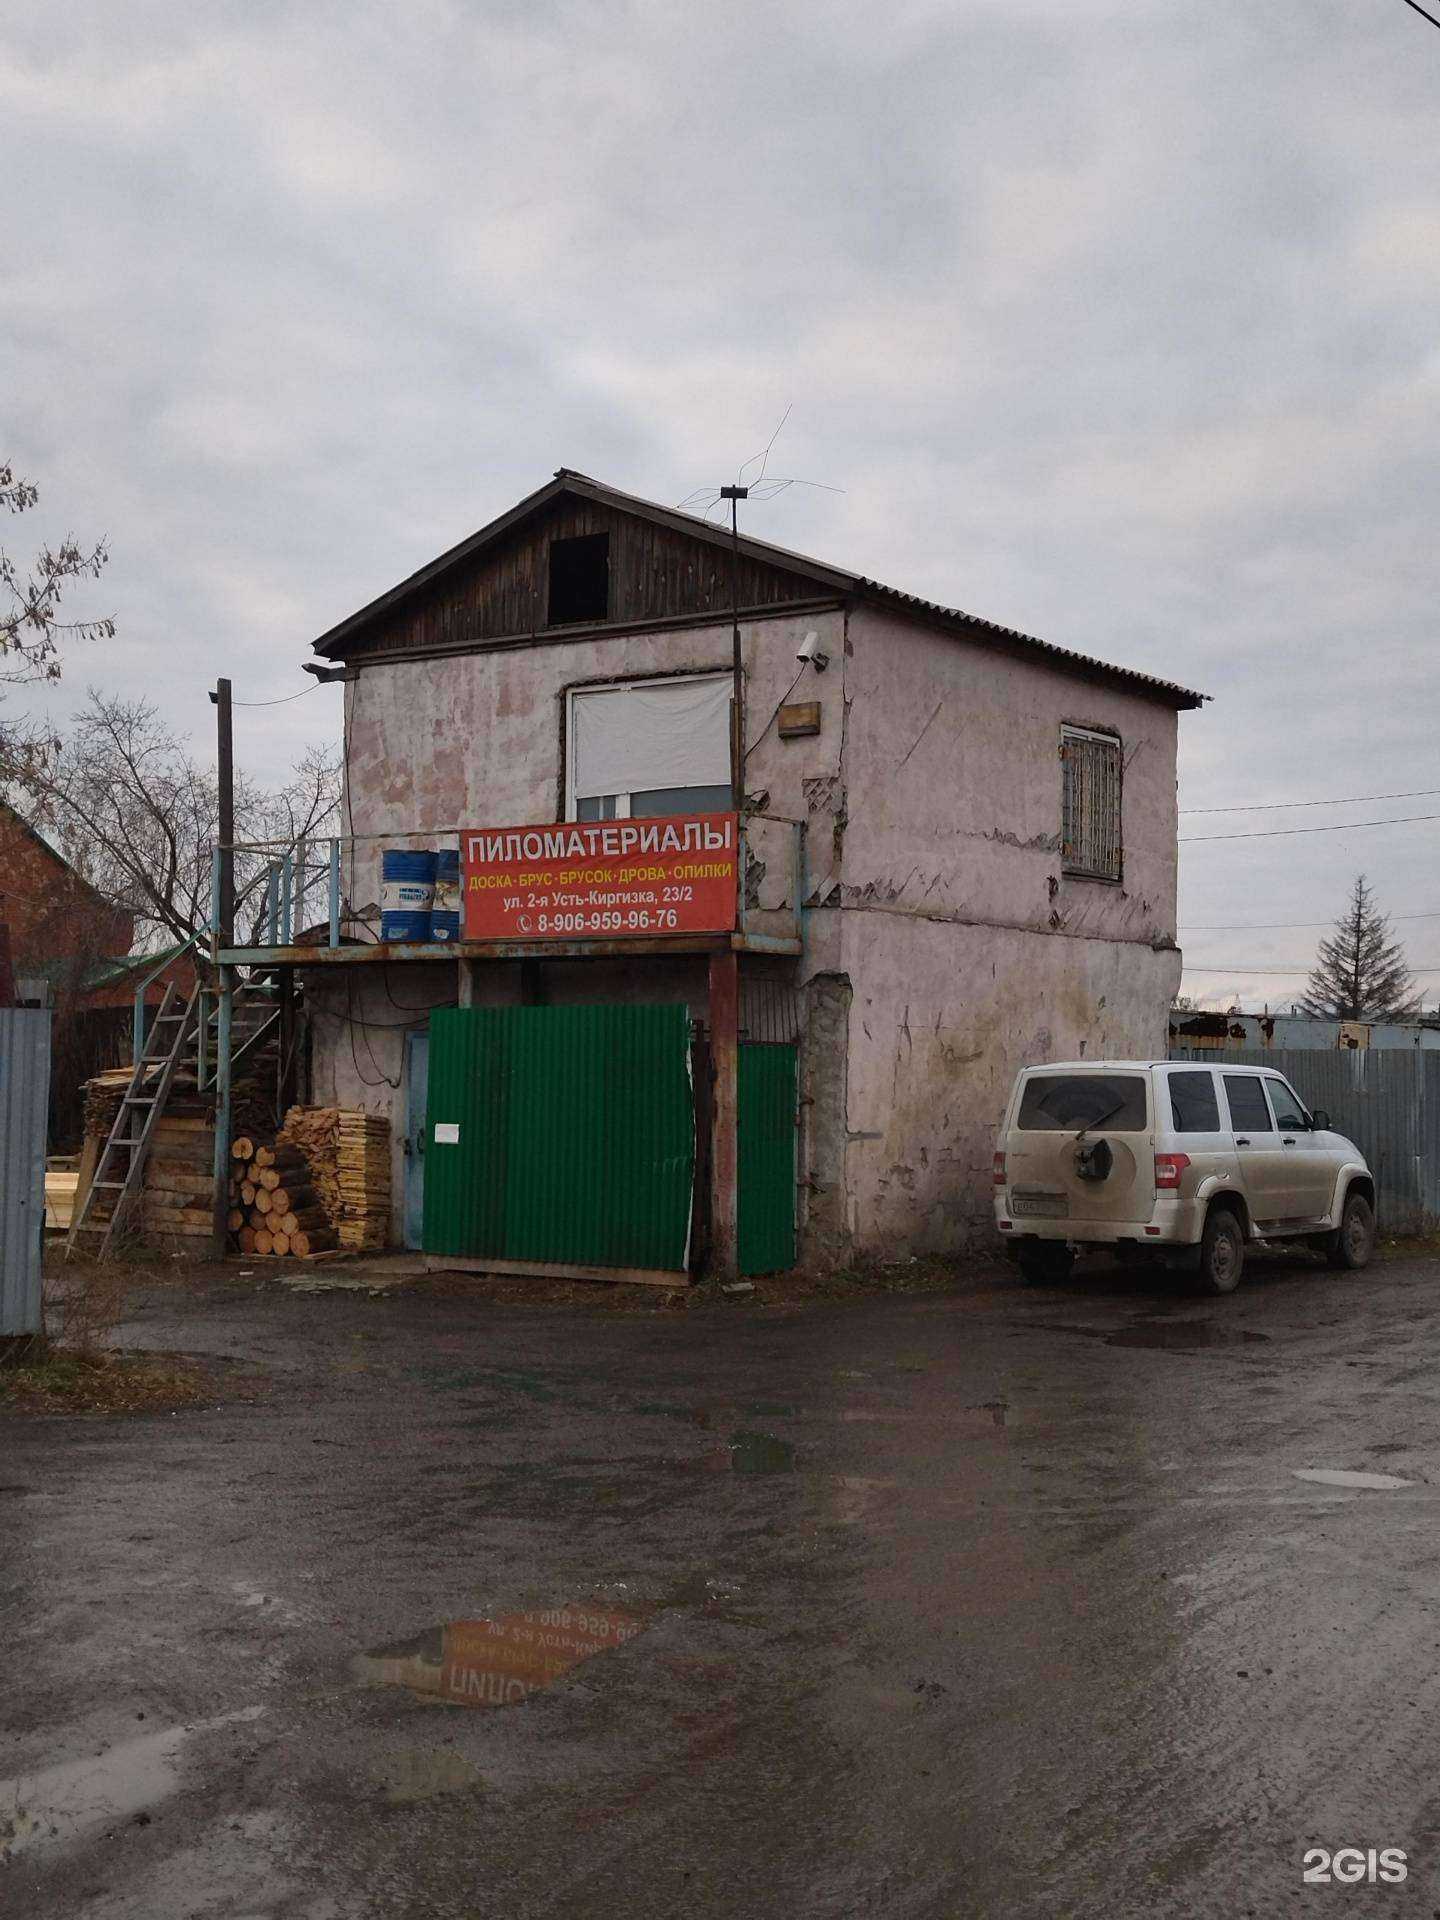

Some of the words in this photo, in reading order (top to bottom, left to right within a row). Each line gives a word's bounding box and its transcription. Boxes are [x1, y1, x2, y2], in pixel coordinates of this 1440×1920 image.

[468, 821, 731, 863] ПИЛОМАТЕРИАЛЫ
[469, 875, 512, 892] ДОСКА
[519, 873, 552, 887] БРУС
[560, 869, 612, 885] БРУСОК
[618, 866, 666, 885] ДРОВА
[673, 863, 731, 880] ОПИЛКИ
[503, 896, 523, 913] ул.
[527, 892, 549, 908] 2-я
[551, 889, 658, 908] Усть-Киргизка,
[662, 885, 693, 902] 23/2
[537, 908, 677, 932] 8-906-959-96-76
